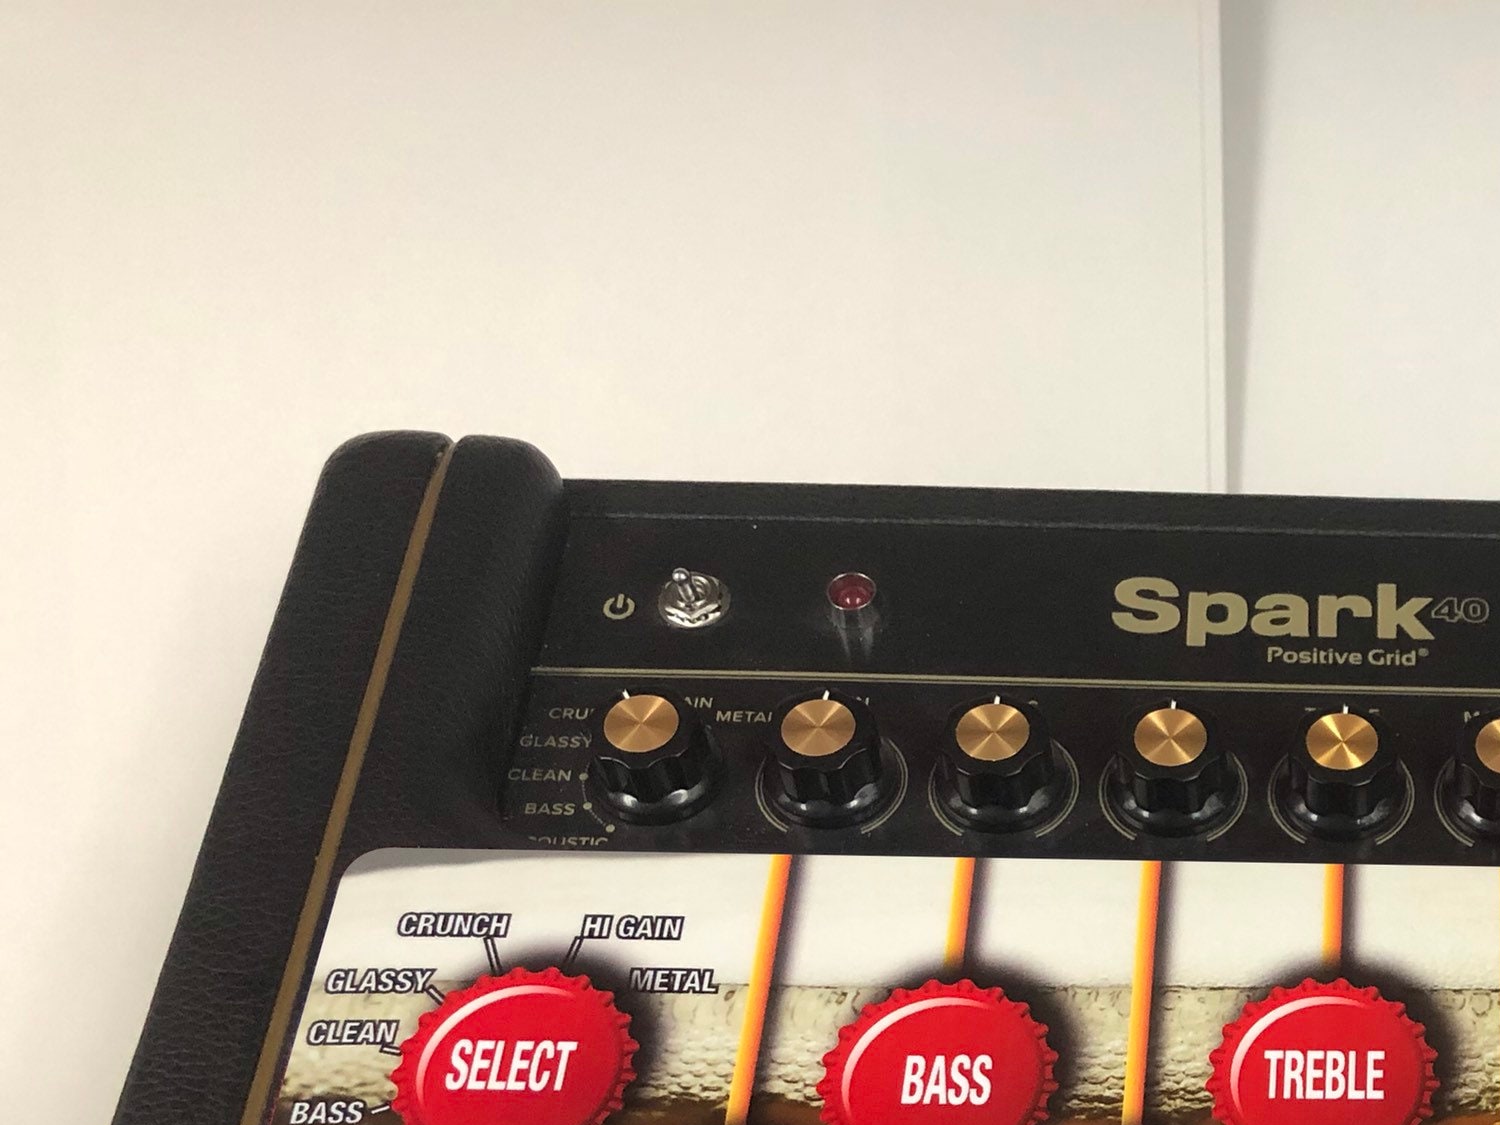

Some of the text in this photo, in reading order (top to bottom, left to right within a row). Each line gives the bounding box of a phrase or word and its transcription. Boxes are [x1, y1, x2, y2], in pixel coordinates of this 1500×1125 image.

[1111, 576, 1490, 647] Spark 40
[1266, 646, 1363, 666] Positive
[519, 733, 593, 749] GLASSY
[507, 768, 572, 782] CLEAN
[524, 802, 576, 816] BASS
[398, 913, 511, 938] CRUNCH
[582, 915, 684, 940] HI GAIN
[325, 968, 436, 994] GLASSY
[629, 967, 719, 994] METAL
[307, 1019, 400, 1045] CLEAN
[445, 1037, 578, 1091] SELECT
[1264, 1049, 1386, 1101] TREBLE
[900, 1053, 994, 1106] BASS
[289, 1101, 364, 1125] BASS
